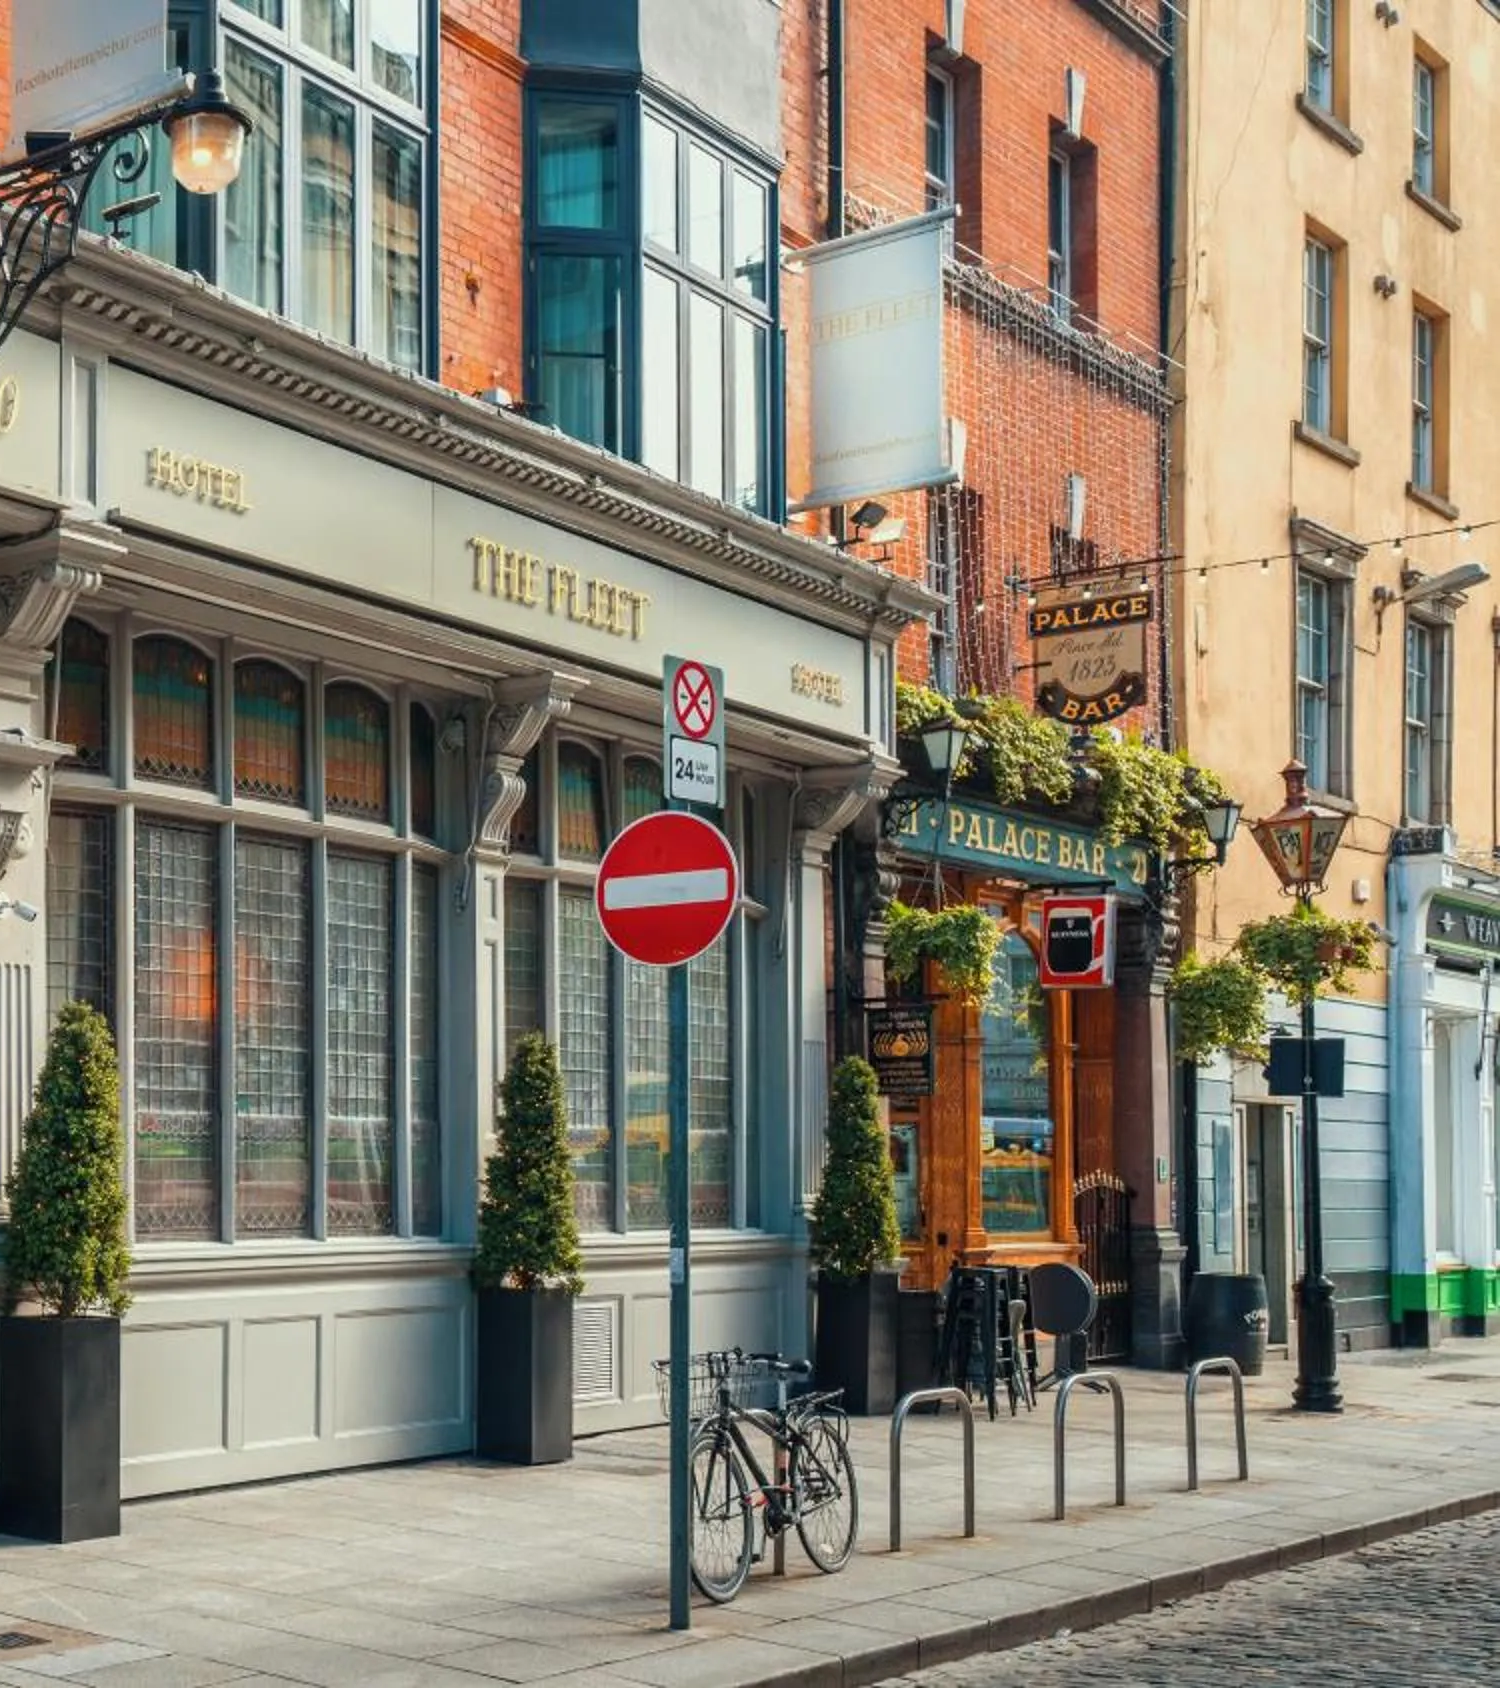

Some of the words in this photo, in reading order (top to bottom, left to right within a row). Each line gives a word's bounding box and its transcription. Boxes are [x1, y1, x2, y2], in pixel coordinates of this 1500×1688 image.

[812, 313, 858, 340] THE
[864, 292, 934, 328] FLEET
[148, 446, 255, 512] HOTEL
[468, 536, 545, 605] THE
[548, 563, 652, 638] FLEET
[1034, 596, 1149, 631] PALACE
[1059, 692, 1128, 720] BAR
[675, 757, 695, 781] 24
[948, 808, 1051, 865] PALACE
[1056, 833, 1107, 877] BAR
